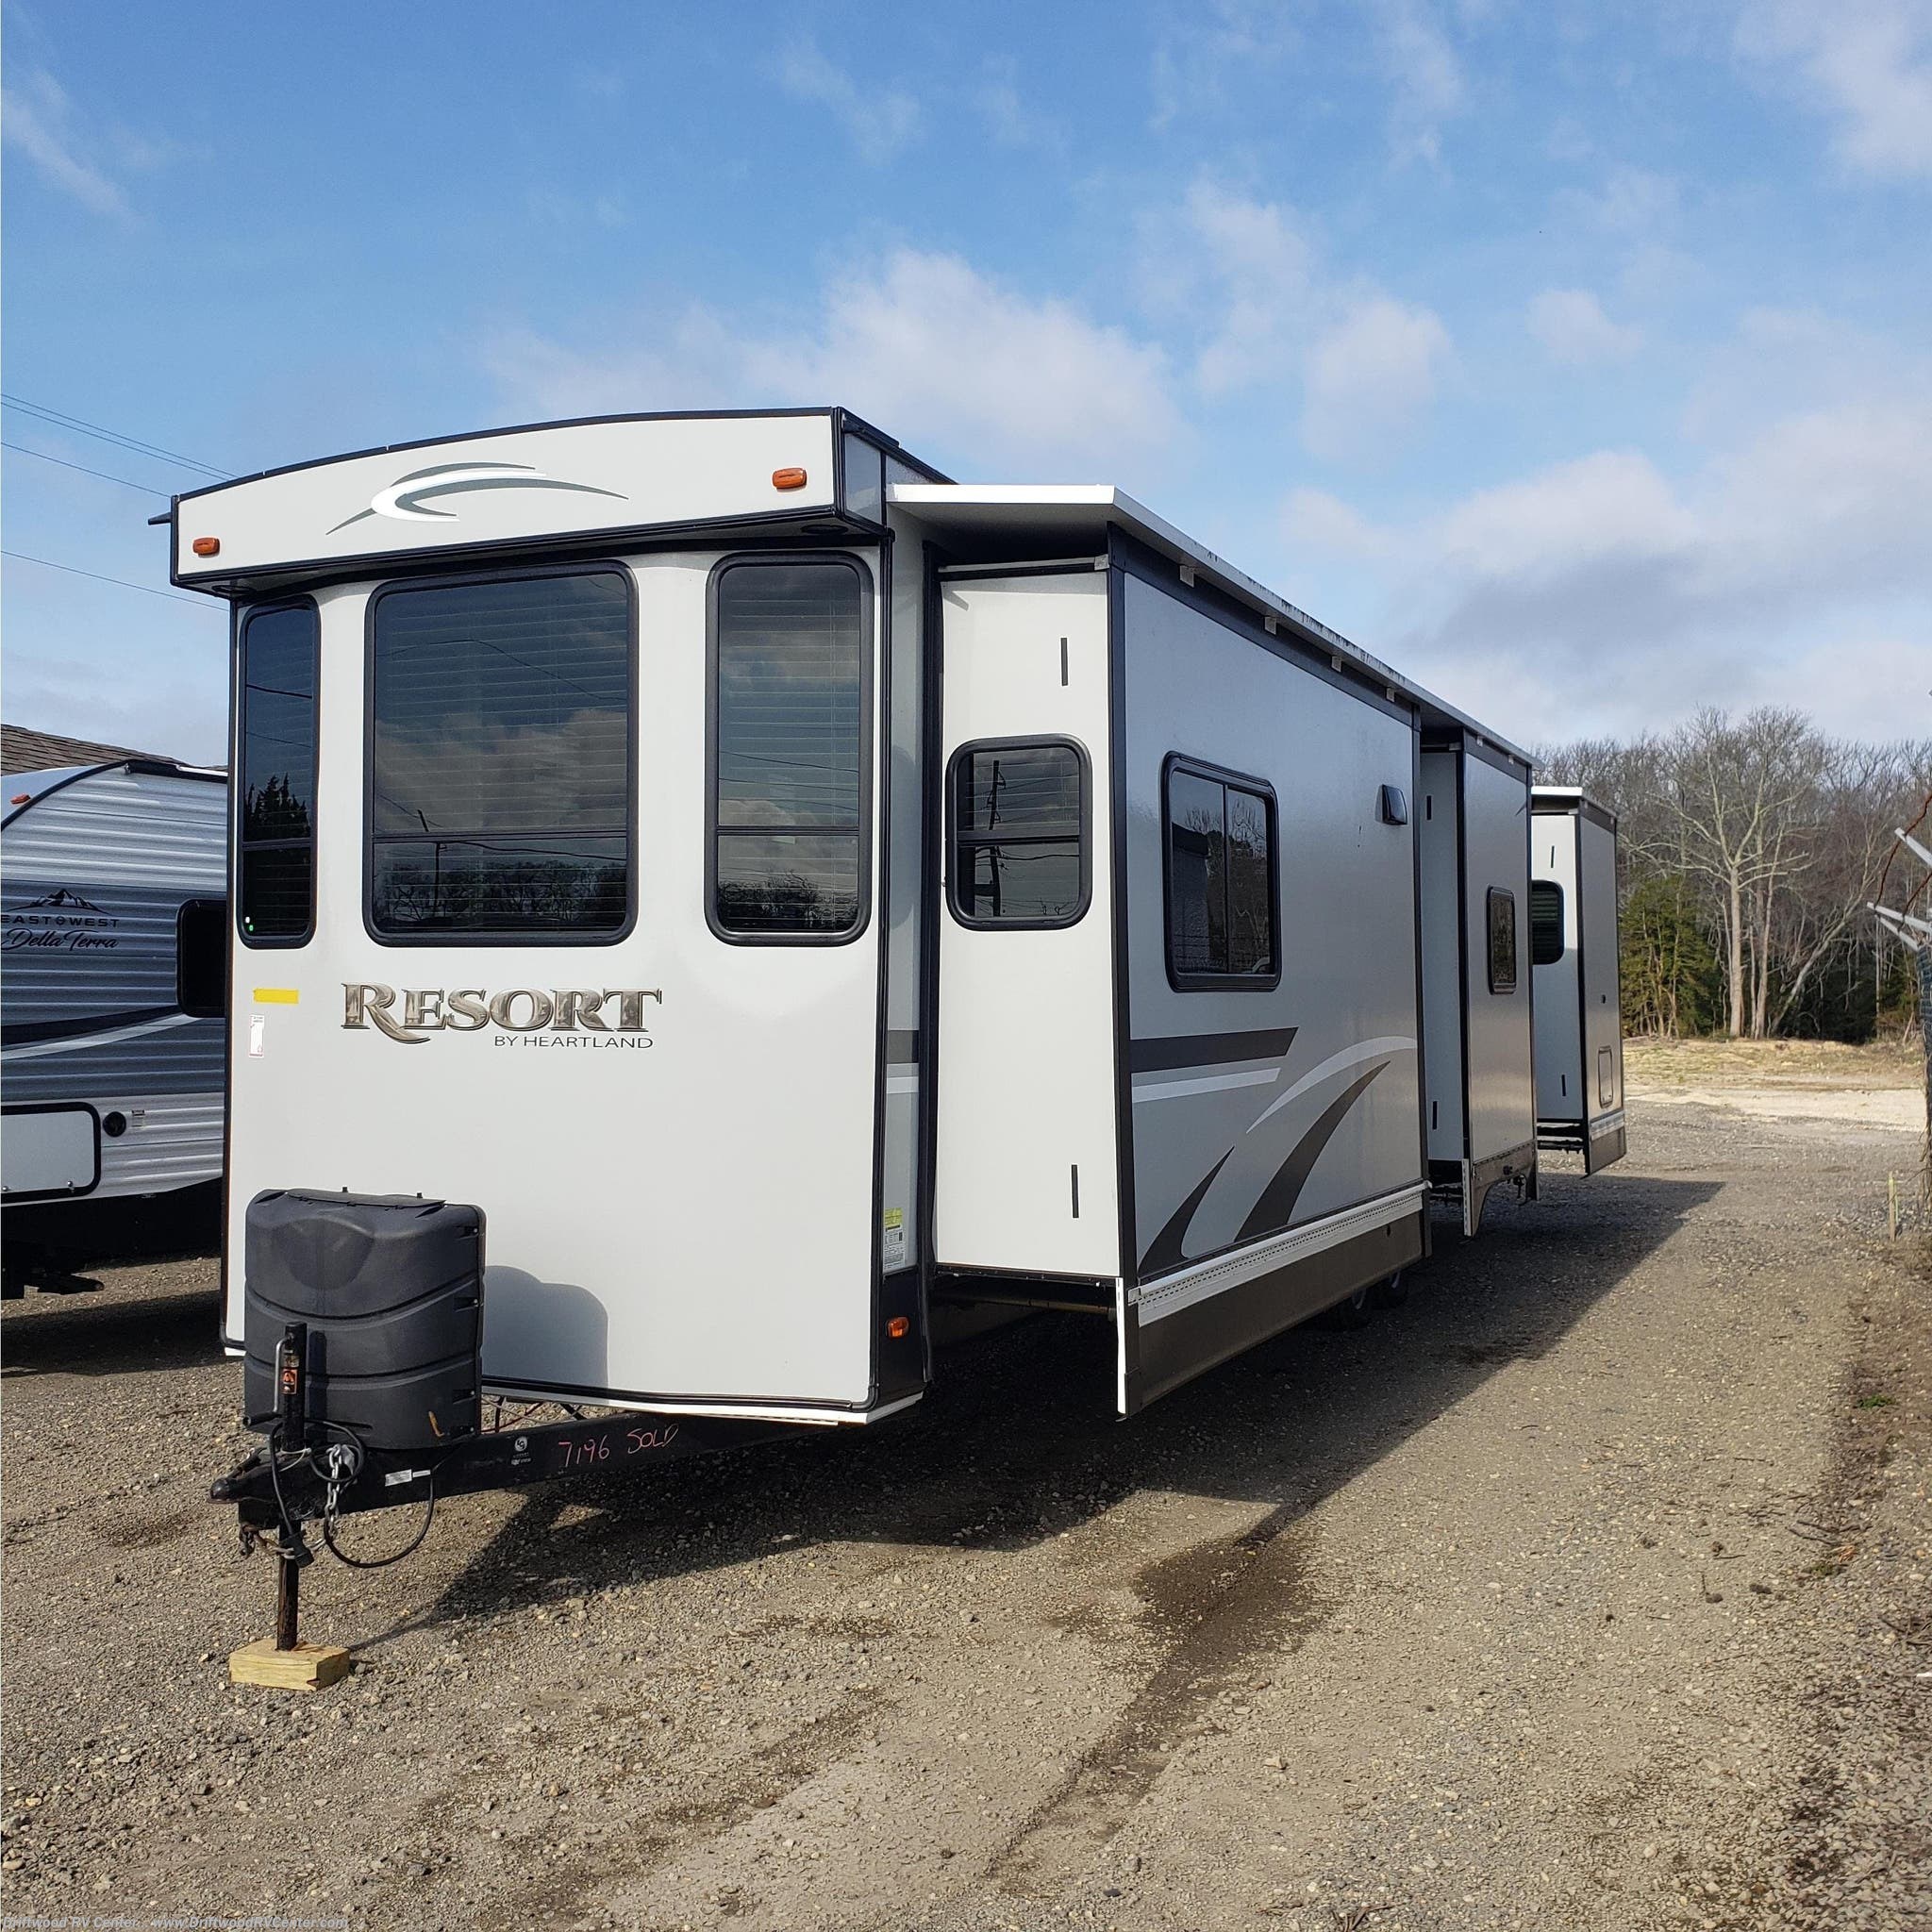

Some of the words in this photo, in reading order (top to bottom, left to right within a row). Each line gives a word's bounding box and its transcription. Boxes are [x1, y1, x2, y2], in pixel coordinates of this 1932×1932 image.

[69, 917, 120, 927] WEST
[1, 927, 64, 950] Della
[63, 930, 119, 951] Terra
[341, 982, 662, 1044] RESORT
[494, 1036, 516, 1047] BY
[524, 1036, 654, 1049] HEARTLAND
[558, 1434, 610, 1468] 7196
[626, 1423, 679, 1455] SOLD
